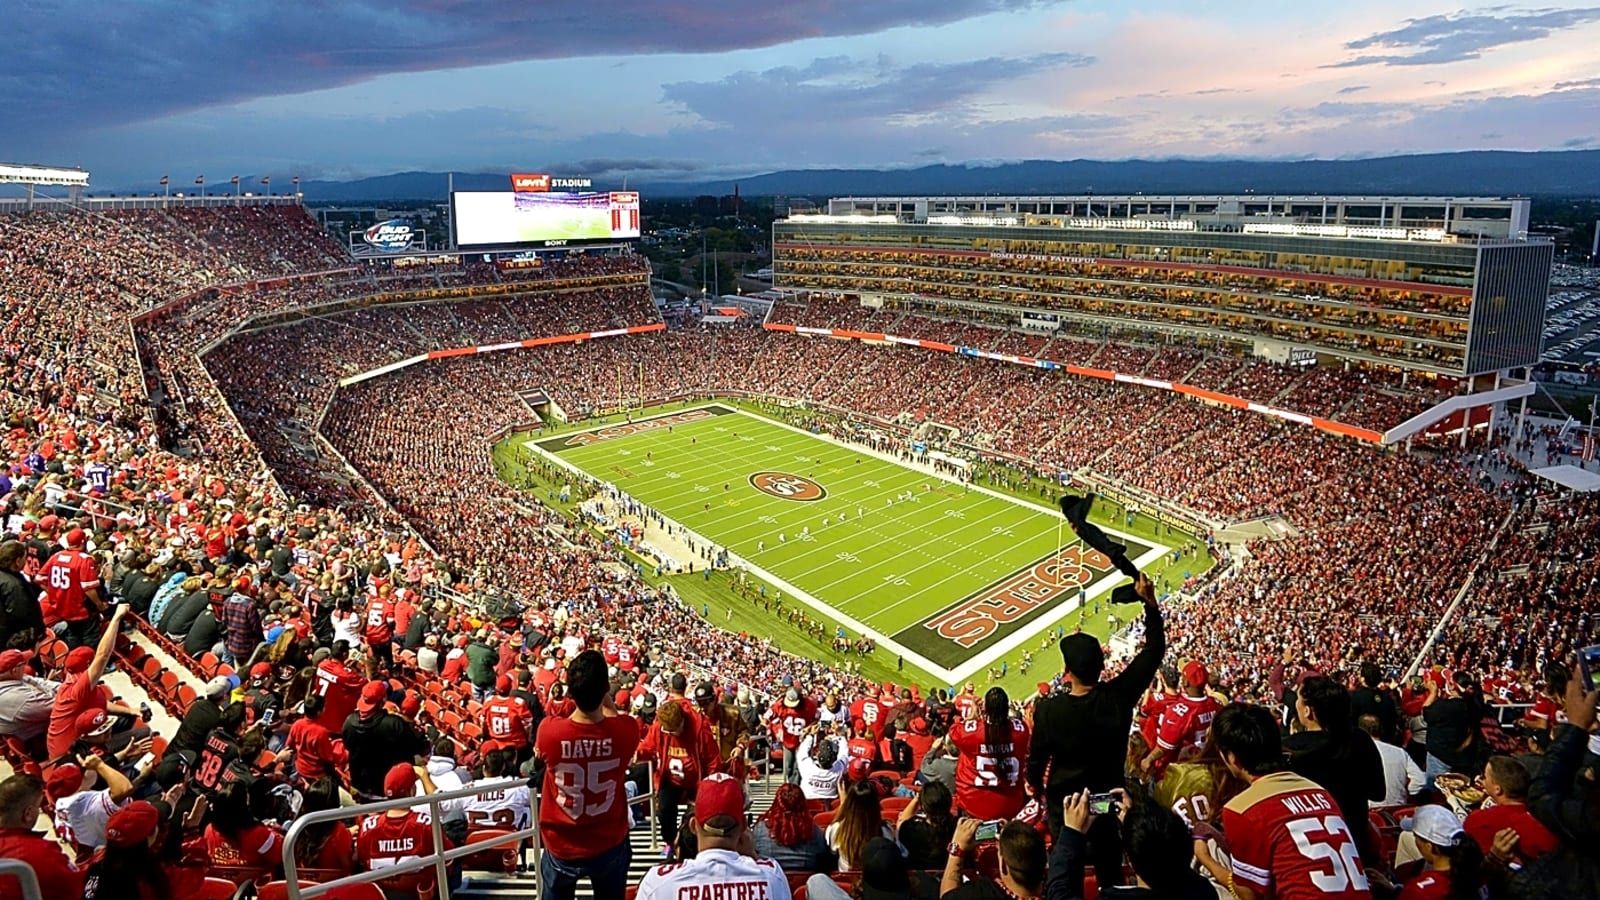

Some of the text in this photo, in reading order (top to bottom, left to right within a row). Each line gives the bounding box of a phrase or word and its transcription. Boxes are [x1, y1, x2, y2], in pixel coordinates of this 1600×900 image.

[551, 179, 591, 187] STADIUM
[366, 233, 414, 241] LIGHT
[379, 225, 410, 234] BUD
[990, 252, 1013, 260] HOME
[1050, 255, 1098, 264] FAITHFUL
[92, 473, 104, 486] 11
[50, 565, 70, 589] 85
[1172, 703, 1189, 716] 52
[492, 716, 510, 735] 81
[561, 738, 613, 759] DAVIS
[195, 750, 222, 788] 38
[554, 758, 621, 820] 85
[1281, 793, 1331, 815] WILLIS
[378, 837, 414, 853] WILLIS
[1285, 815, 1370, 893] 52
[678, 881, 770, 900] CRABTREE
